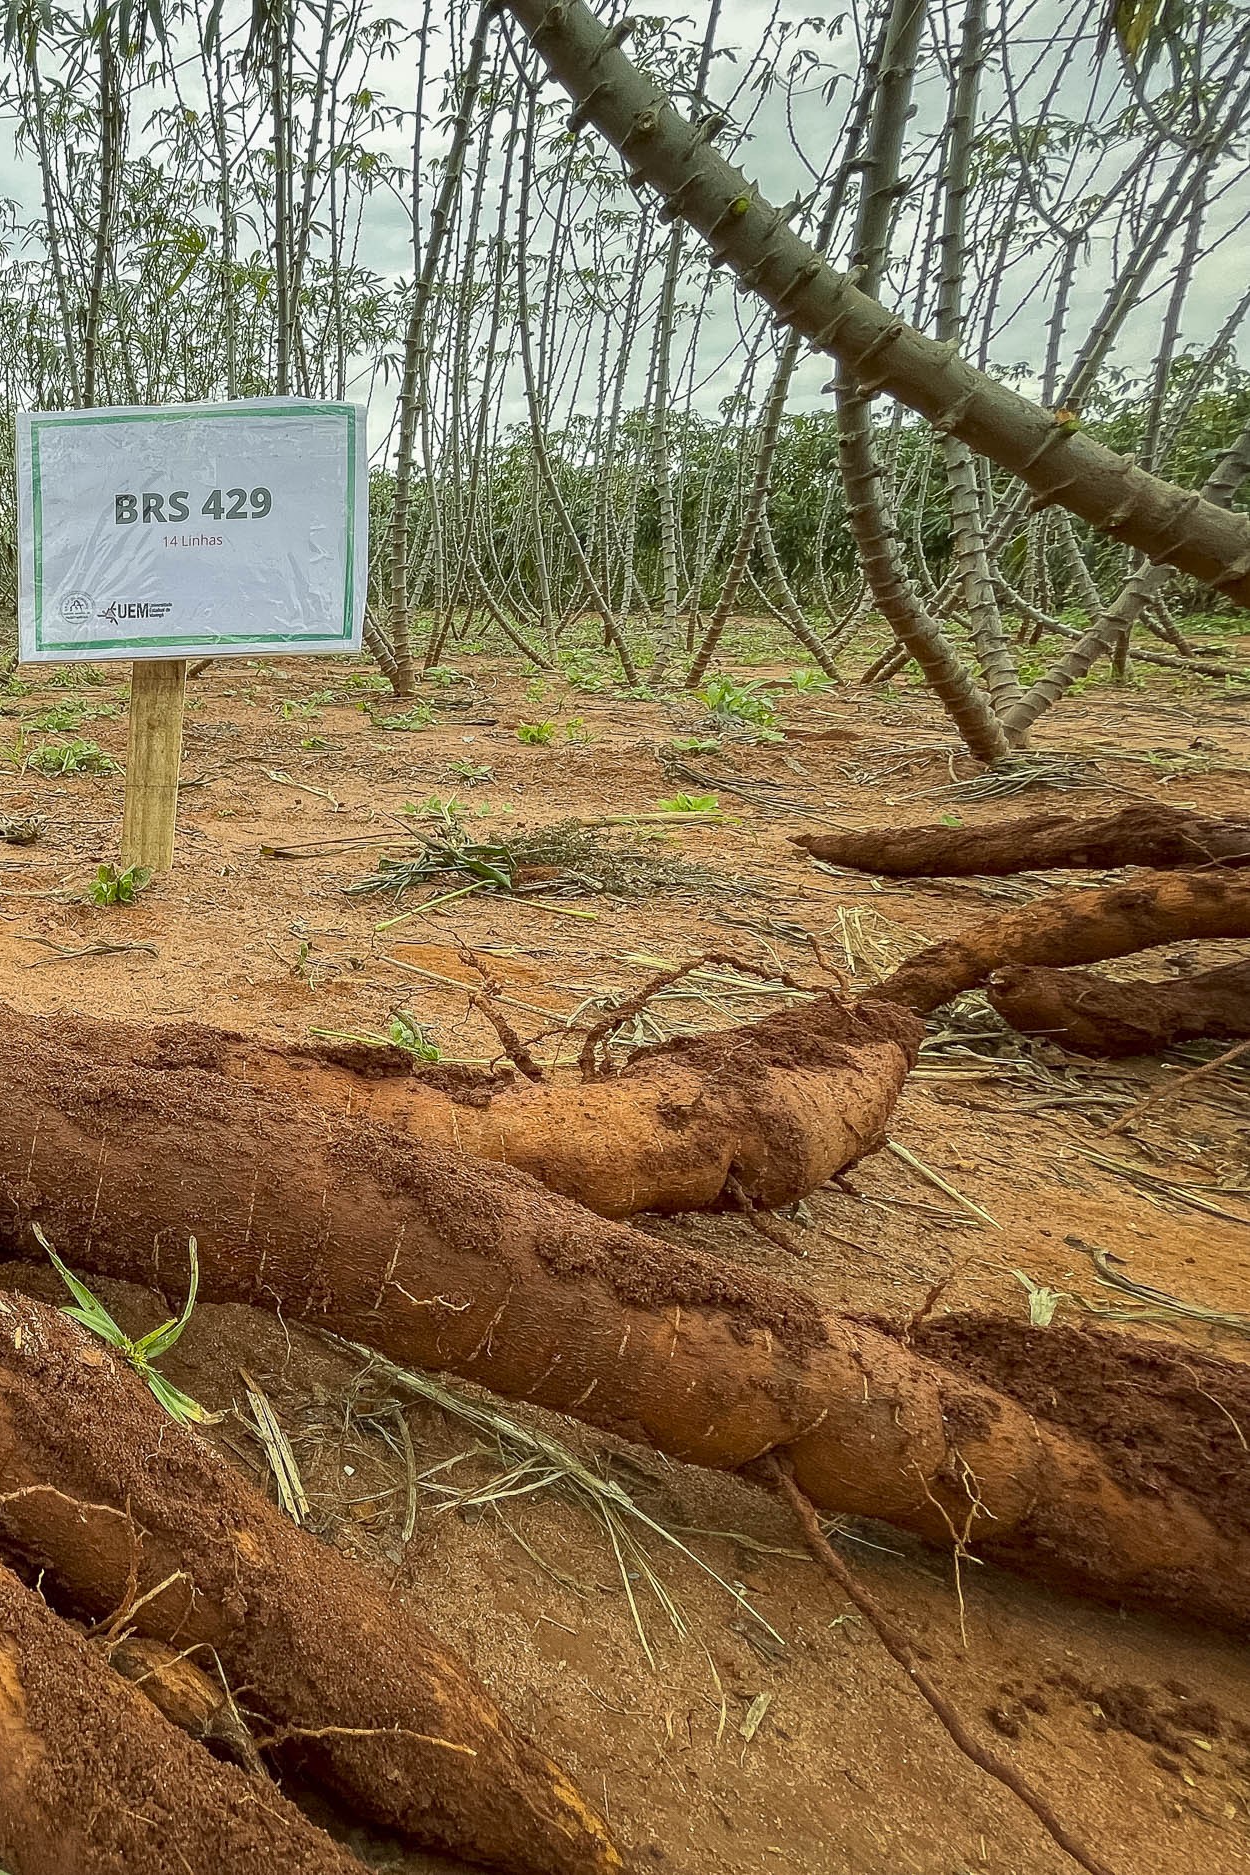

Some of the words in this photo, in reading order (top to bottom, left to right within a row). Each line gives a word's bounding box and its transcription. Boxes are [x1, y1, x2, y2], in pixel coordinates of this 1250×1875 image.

[115, 491, 190, 525] BRS
[201, 487, 272, 520] 429
[163, 536, 179, 548] 14
[182, 534, 223, 547] Linhas
[118, 602, 149, 619] UEM
